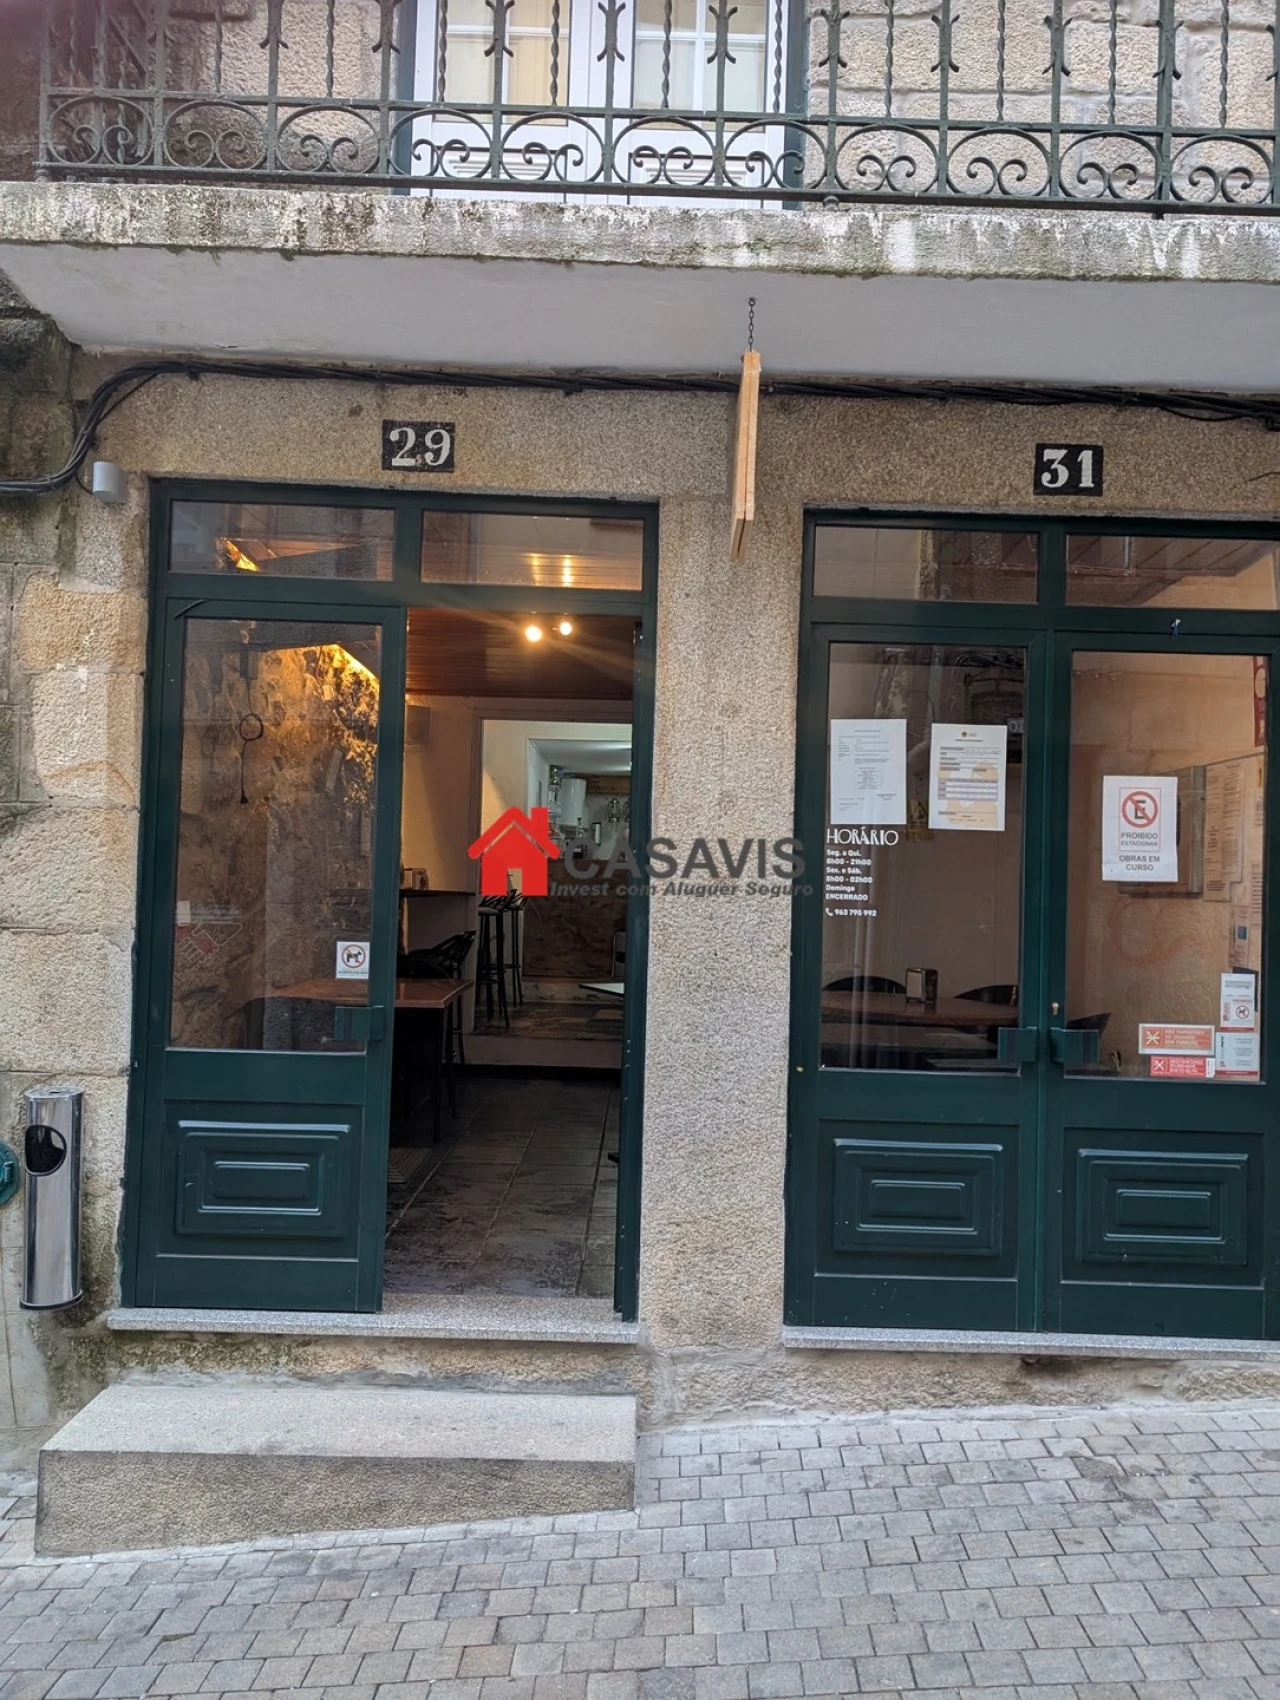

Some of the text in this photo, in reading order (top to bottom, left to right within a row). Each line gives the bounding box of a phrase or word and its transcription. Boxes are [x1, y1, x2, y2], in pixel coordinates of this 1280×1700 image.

[389, 427, 451, 466] 29
[1041, 449, 1095, 488] 31
[827, 825, 899, 846] HORÁRIO
[826, 849, 841, 857] Seg.
[847, 867, 863, 875] Sáb.
[826, 875, 844, 883] 8h00
[826, 884, 855, 893] Domingo
[863, 909, 877, 917] 992
